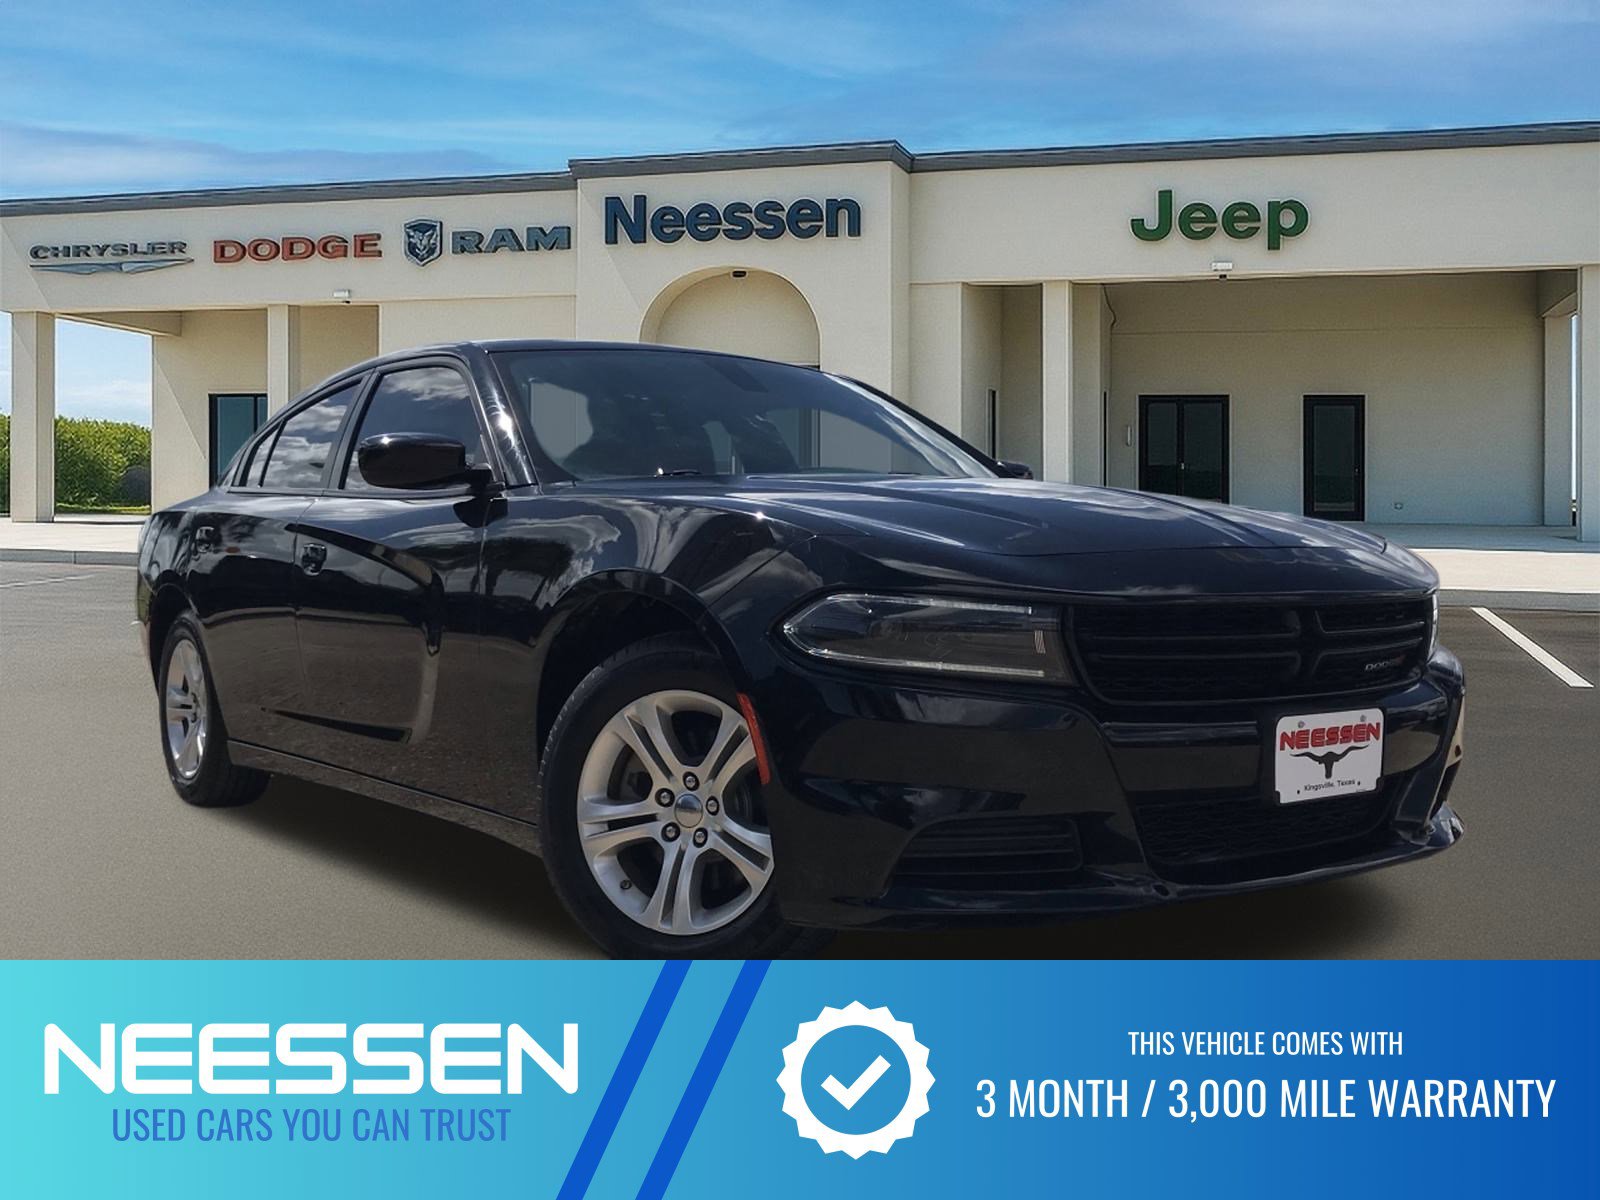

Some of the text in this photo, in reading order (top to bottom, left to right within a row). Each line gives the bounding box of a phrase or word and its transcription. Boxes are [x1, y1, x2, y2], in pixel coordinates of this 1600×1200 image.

[604, 194, 862, 245] Neessen
[1130, 189, 1309, 251] Jeep
[29, 241, 188, 260] CHRYSLER
[213, 233, 383, 264] DODGE
[452, 226, 572, 254] RAM
[1280, 722, 1381, 752] NEESSEN
[1337, 779, 1356, 788] Texas
